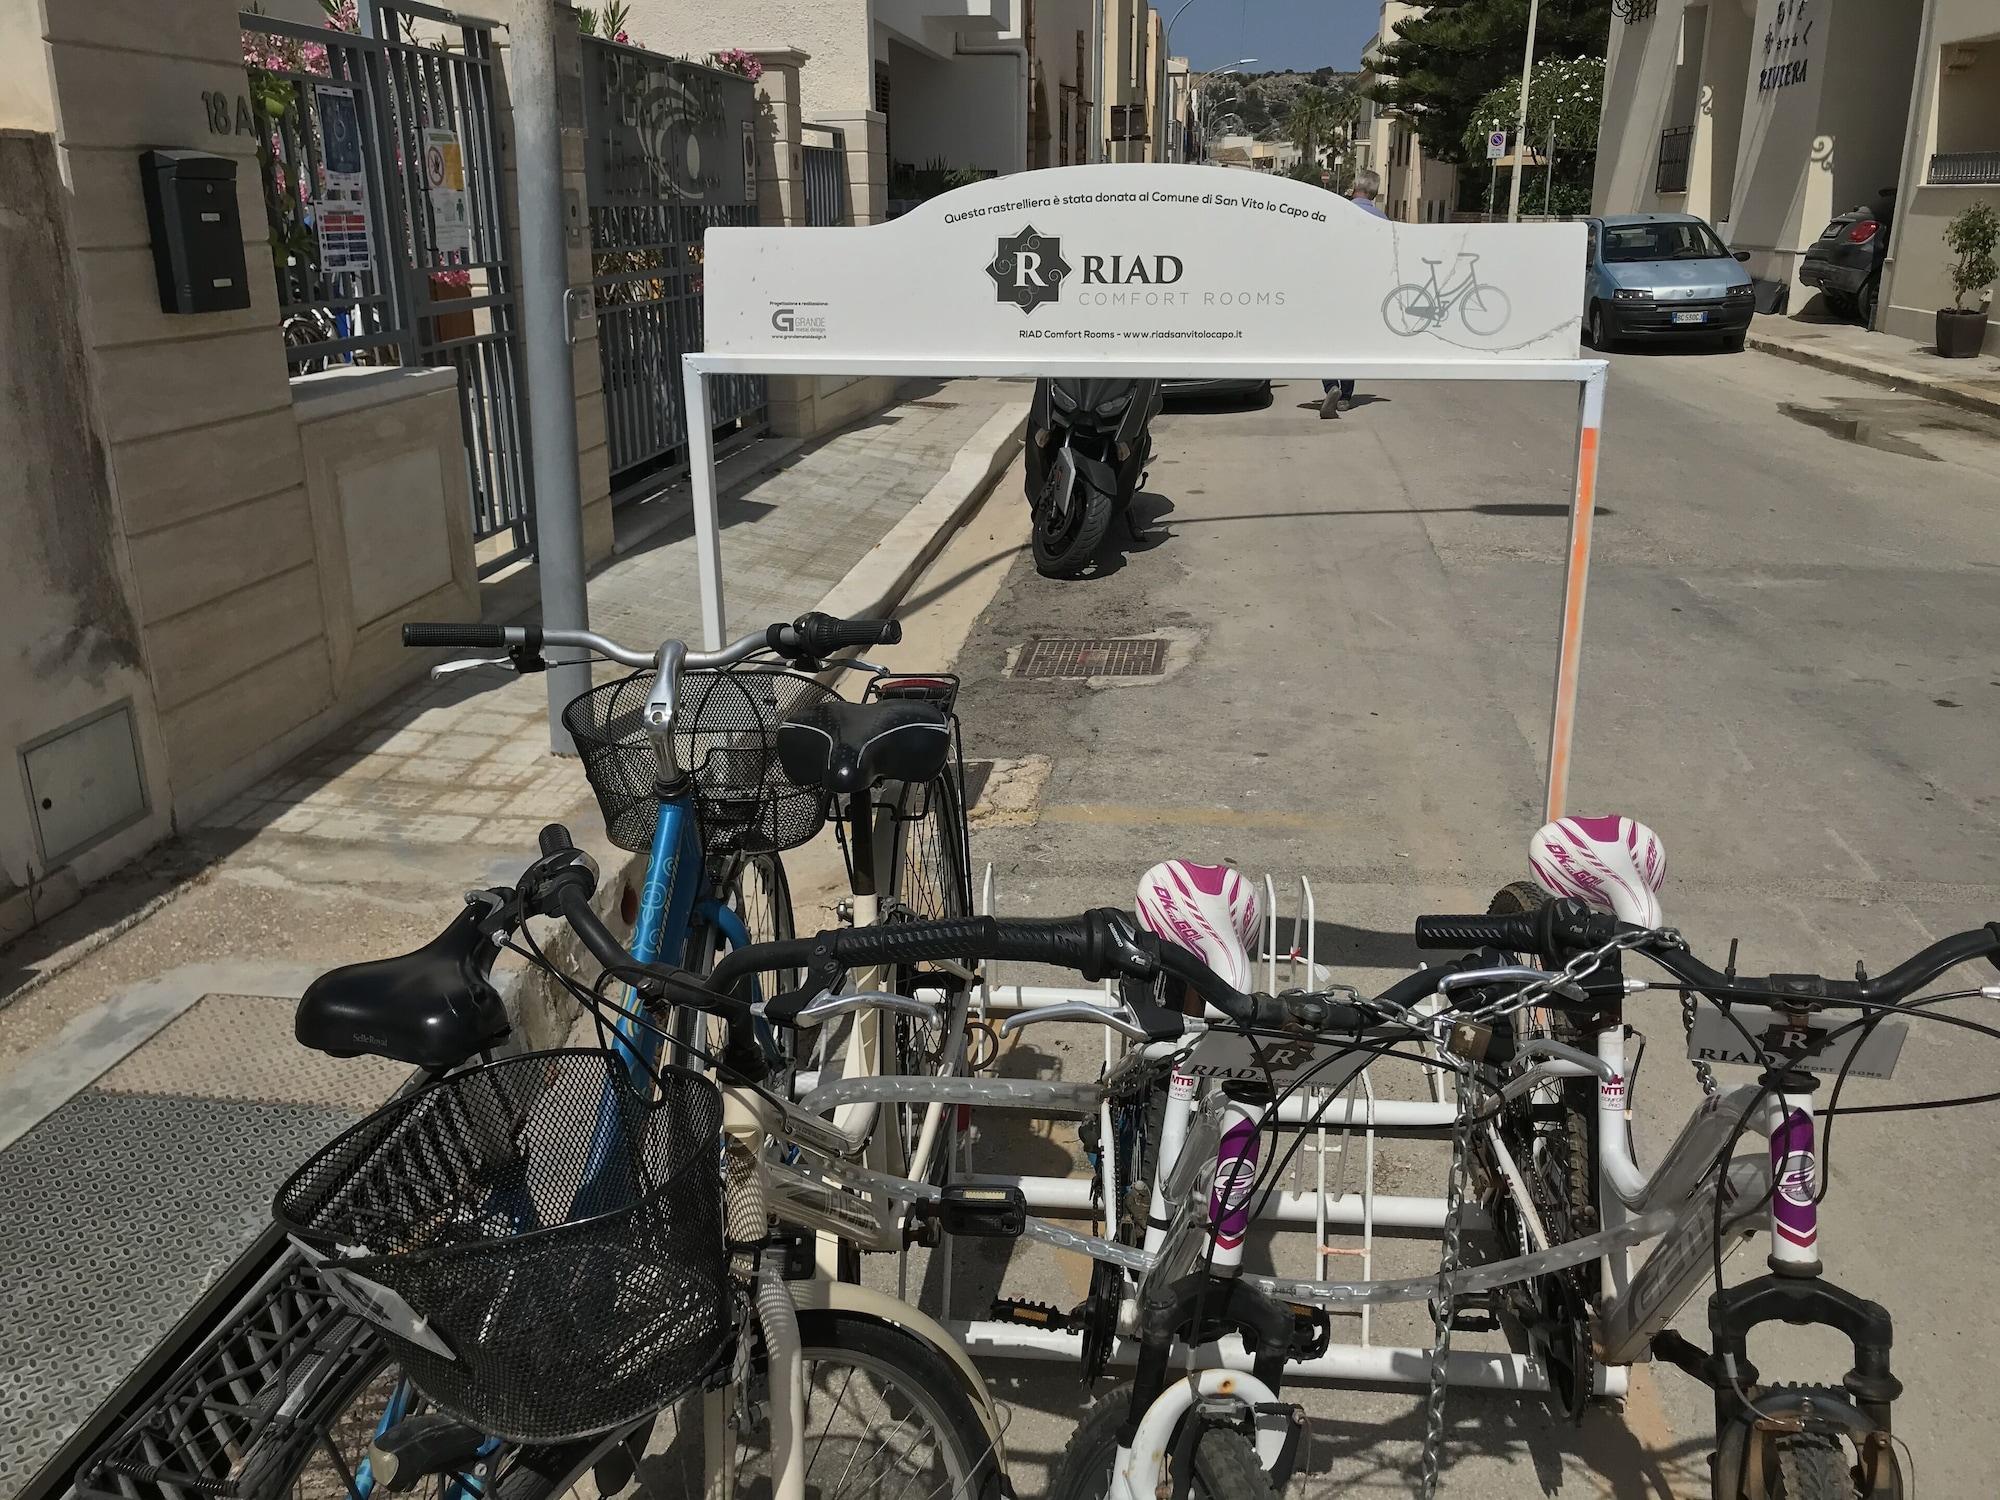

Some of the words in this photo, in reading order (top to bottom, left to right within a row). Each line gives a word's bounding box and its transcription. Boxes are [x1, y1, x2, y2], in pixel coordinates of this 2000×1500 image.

[944, 208, 986, 224] Questa
[988, 197, 1051, 215] rastrelliera
[1053, 194, 1060, 205] è
[1063, 193, 1093, 204] stata
[1095, 192, 1137, 203] donata
[1138, 191, 1149, 202] al
[1151, 191, 1200, 203] Comune
[1201, 193, 1213, 204] di
[1215, 194, 1238, 207] San
[1241, 196, 1264, 210] Vito
[1266, 200, 1277, 212] lo
[1279, 203, 1309, 219] Capo
[1311, 210, 1327, 223] da
[1012, 251, 1049, 288] R
[1080, 254, 1184, 285] RIAD
[1078, 291, 1190, 306] COMFORT
[1203, 291, 1286, 306] ROOMS
[795, 317, 825, 328] GRANDE
[1019, 329, 1042, 339] RIAD
[1044, 329, 1082, 339] Comfort
[1084, 329, 1115, 339] Rooms
[1123, 329, 1243, 341] www.riadsanvitolocapo.it
[1781, 1031, 1808, 1049] R
[1268, 1049, 1296, 1066] R
[1699, 1048, 1776, 1065] RIAD
[1190, 1064, 1257, 1079] RIAD
[1847, 1070, 1882, 1078] OOMS
[1172, 1075, 1194, 1087] MTB
[1600, 1085, 1625, 1096] MTB
